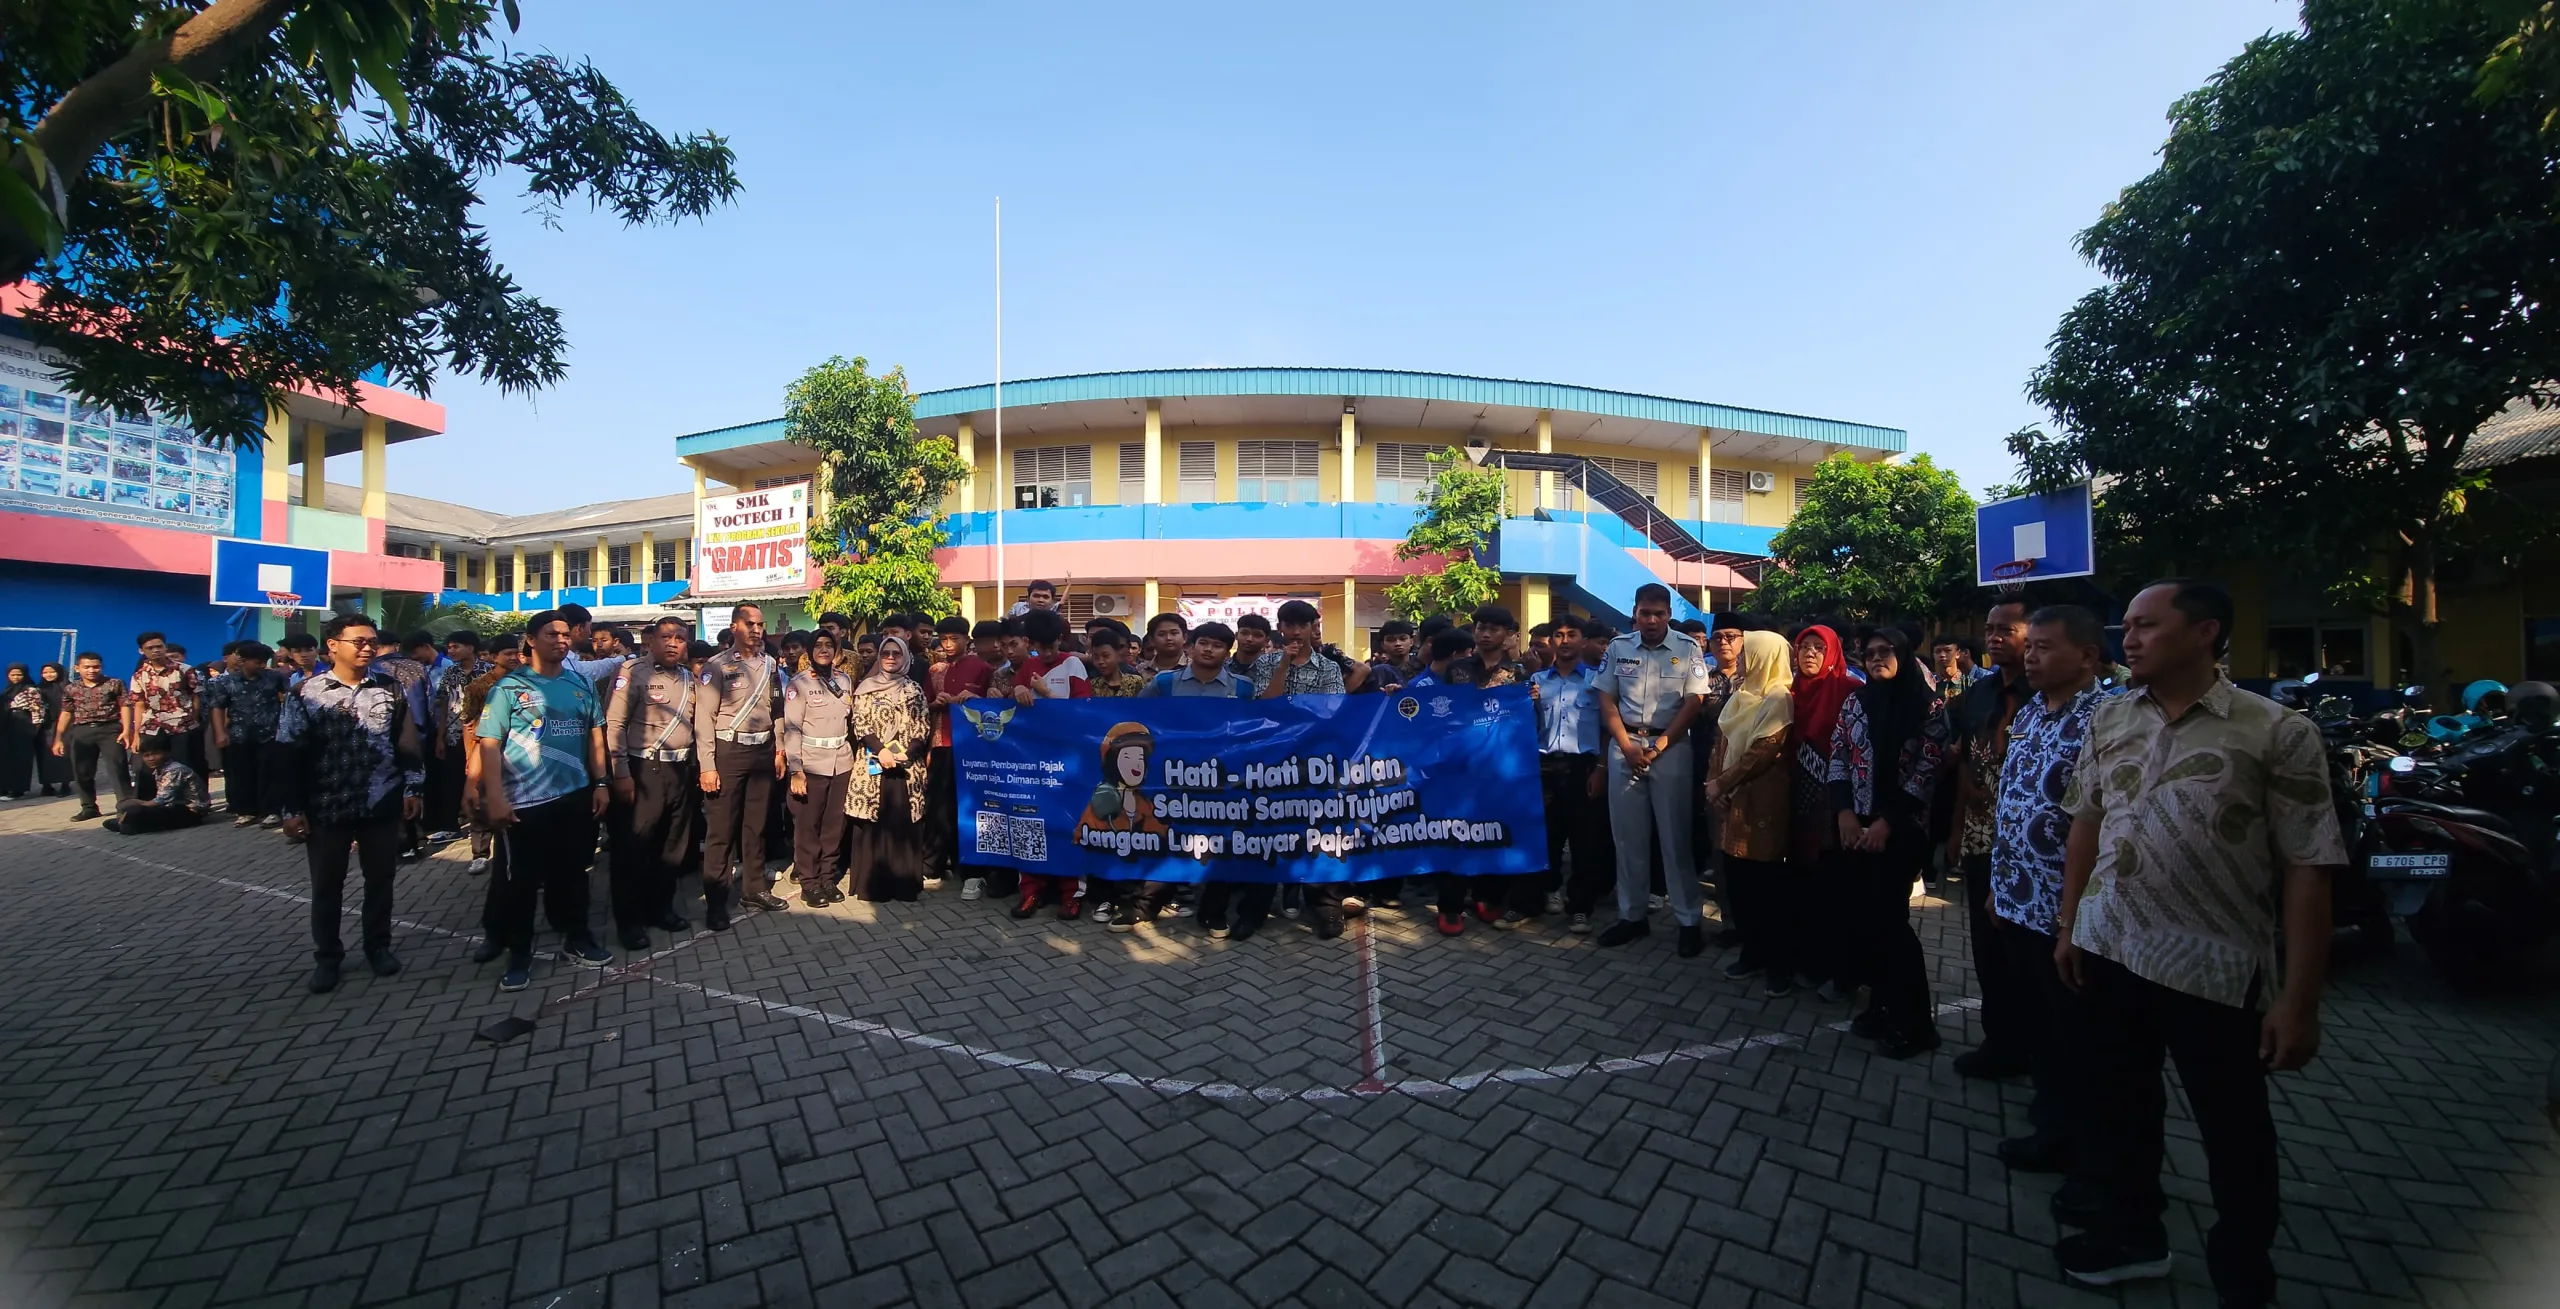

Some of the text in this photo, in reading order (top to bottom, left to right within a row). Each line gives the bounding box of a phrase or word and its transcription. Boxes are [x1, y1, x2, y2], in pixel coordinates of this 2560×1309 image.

[736, 494, 769, 510] SMK
[57, 505, 95, 514] karakter
[98, 511, 134, 520] generasi
[136, 515, 160, 523] muda
[713, 509, 782, 528] VOCTECH
[725, 528, 764, 543] PROGRAM
[766, 523, 800, 538] SEKOLAH
[1039, 760, 1065, 774] Pajak
[1165, 758, 1218, 788] Hati
[1245, 756, 1299, 790] Hati
[1307, 753, 1335, 785] Di
[1339, 755, 1401, 786] Jalan
[1153, 788, 1415, 825] Selamat Sampai Tujuan
[1079, 814, 1503, 861] Jangan Lupa Bayar Pajak Kendaraan
[2373, 857, 2379, 866] B
[2386, 856, 2415, 866] 6706
